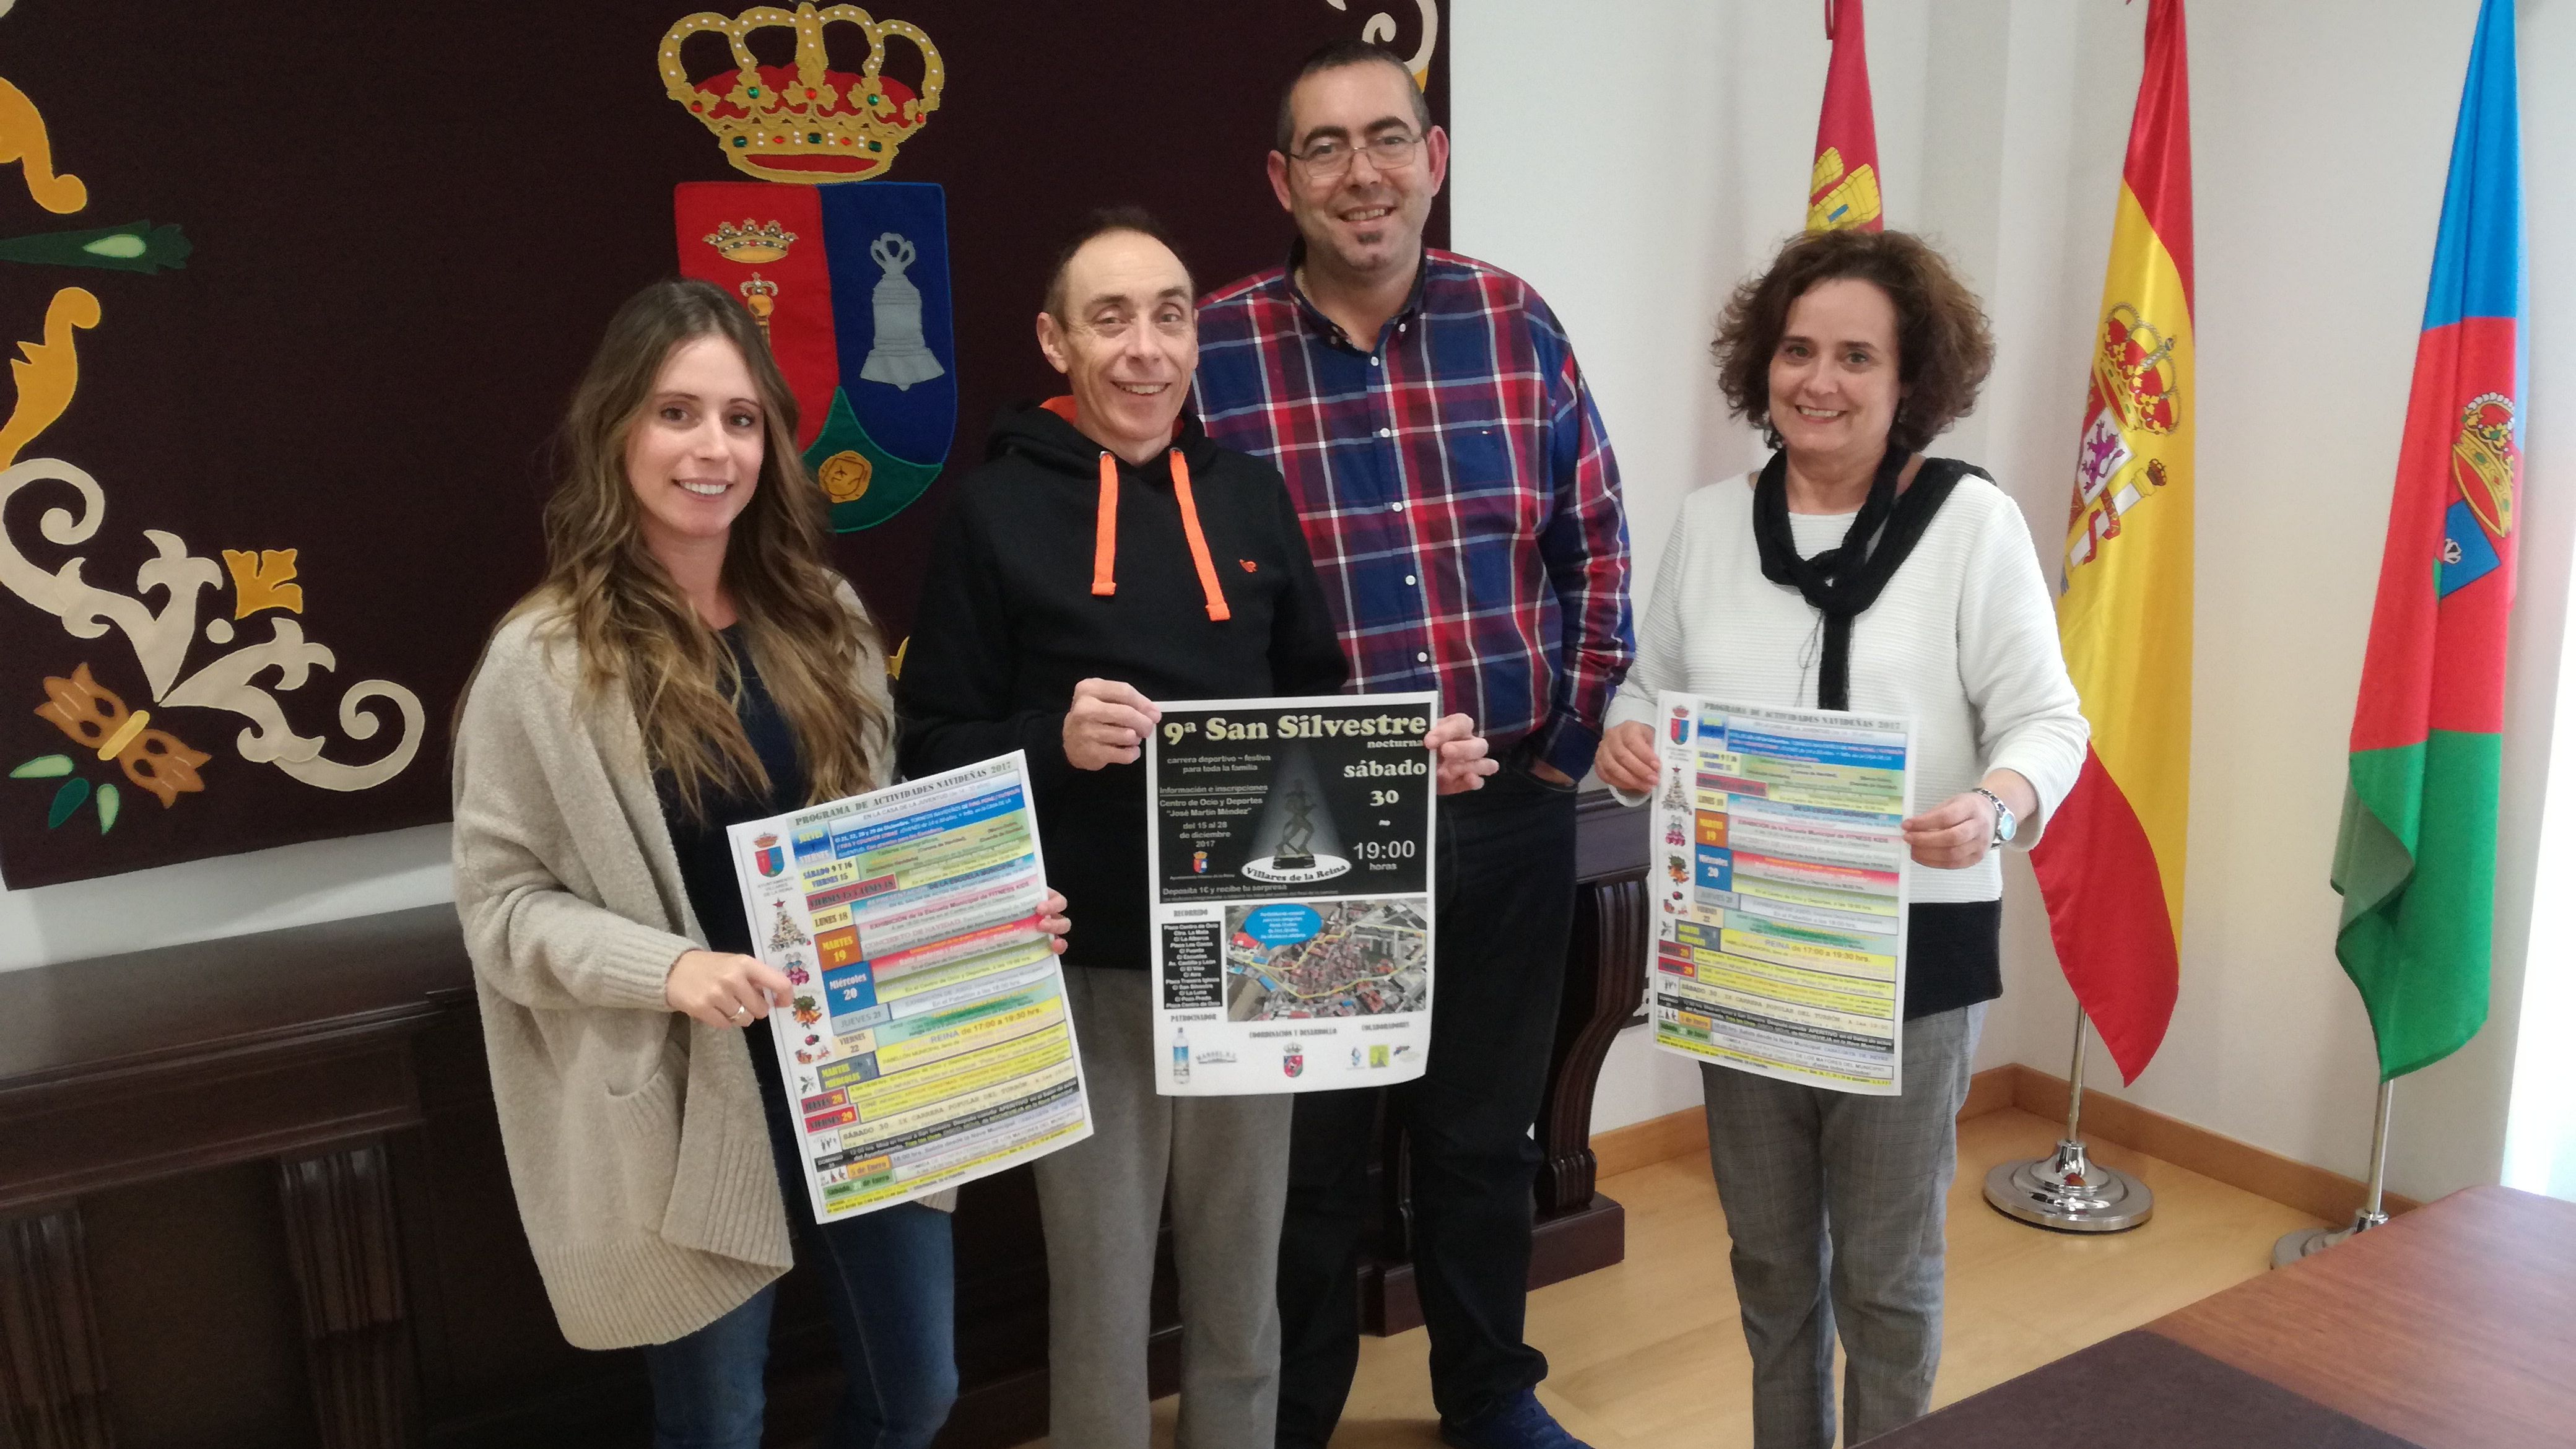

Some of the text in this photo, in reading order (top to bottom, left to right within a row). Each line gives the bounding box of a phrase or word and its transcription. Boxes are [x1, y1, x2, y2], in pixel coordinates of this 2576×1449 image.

[1765, 710, 1819, 723] ACTIVIDADES
[1822, 714, 1873, 728] NAVIDEÑAS
[1878, 720, 1900, 730] 2017
[1164, 715, 1427, 745] 9ª San Silvestre
[1367, 738, 1424, 749] nocturna
[1198, 754, 1236, 764] deportivo
[1244, 753, 1271, 761] festiva
[1344, 759, 1427, 778] sábado
[794, 805, 850, 826] PROGRAMA
[855, 800, 868, 811] DE
[872, 782, 934, 806] ACTIVIDADES
[936, 767, 986, 789] NAVIDEÑAS
[990, 761, 1011, 773] 2017
[1159, 785, 1206, 794] Información
[1215, 783, 1268, 793] inscripciones
[881, 806, 895, 815] CASA
[917, 792, 949, 806] JUVENTUD
[1159, 799, 1186, 807] Centro
[1226, 796, 1262, 806] Deportes
[1370, 790, 1399, 806] 30
[1191, 830, 1231, 838] diciembre
[1353, 840, 1415, 860] 19:00
[831, 864, 837, 872] 9
[843, 859, 853, 869] 16
[1246, 867, 1287, 882] Villares
[1289, 873, 1302, 882] de
[1303, 871, 1315, 881] la
[1316, 864, 1347, 878] Reina
[1369, 861, 1397, 871] horas
[812, 872, 848, 888] VIERNES 15
[1251, 884, 1287, 892] sorpresa
[988, 884, 1014, 897] FITNESS
[1016, 881, 1029, 889] KIDS
[814, 911, 848, 928] LUNES 18
[822, 935, 853, 951] MARTES
[1765, 939, 1788, 949] REINA
[1791, 944, 1801, 952] de
[1803, 946, 1823, 955] 17:00
[1832, 950, 1853, 960] 19:30
[1855, 954, 1870, 963] hrs.
[833, 949, 847, 962] 19
[829, 971, 867, 990] Miércoles
[842, 986, 858, 1001] 20
[840, 1009, 881, 1028] JUEVES 21
[931, 1029, 959, 1043] REINA
[961, 1026, 972, 1035] de
[973, 1019, 995, 1032] 17:00
[1004, 1010, 1025, 1023] 19:30
[839, 1032, 866, 1046] VIERNES
[850, 1043, 859, 1053] 22
[841, 1110, 853, 1122] 29
[842, 1125, 874, 1141] SÁBADO
[879, 1121, 889, 1129] 30
